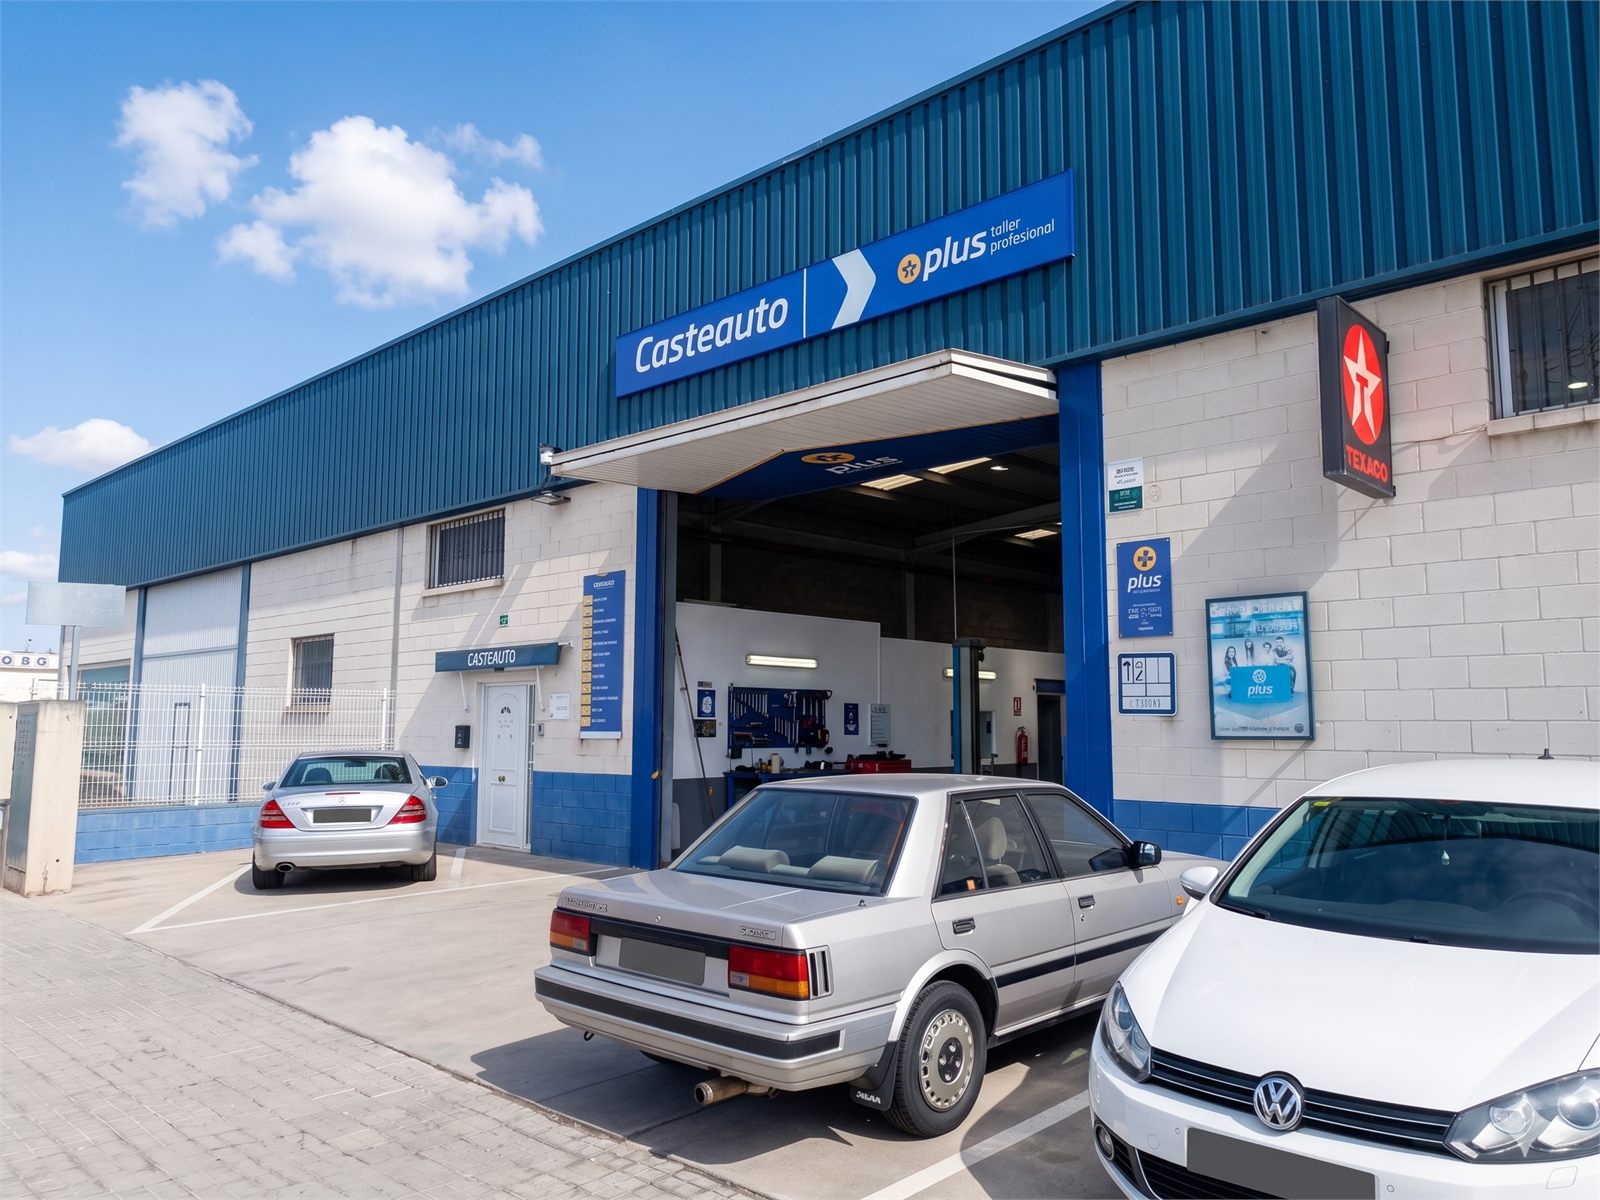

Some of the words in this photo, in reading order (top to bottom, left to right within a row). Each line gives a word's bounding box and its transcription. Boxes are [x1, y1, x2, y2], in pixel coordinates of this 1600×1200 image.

[990, 218, 1055, 256] profesional
[991, 217, 1021, 235] taller
[922, 231, 986, 281] plus
[635, 297, 788, 374] Casteauto
[824, 457, 898, 474] plus
[1345, 444, 1387, 482] TEXACO
[1127, 574, 1162, 592] plus
[467, 649, 516, 666] CASTEAUTO
